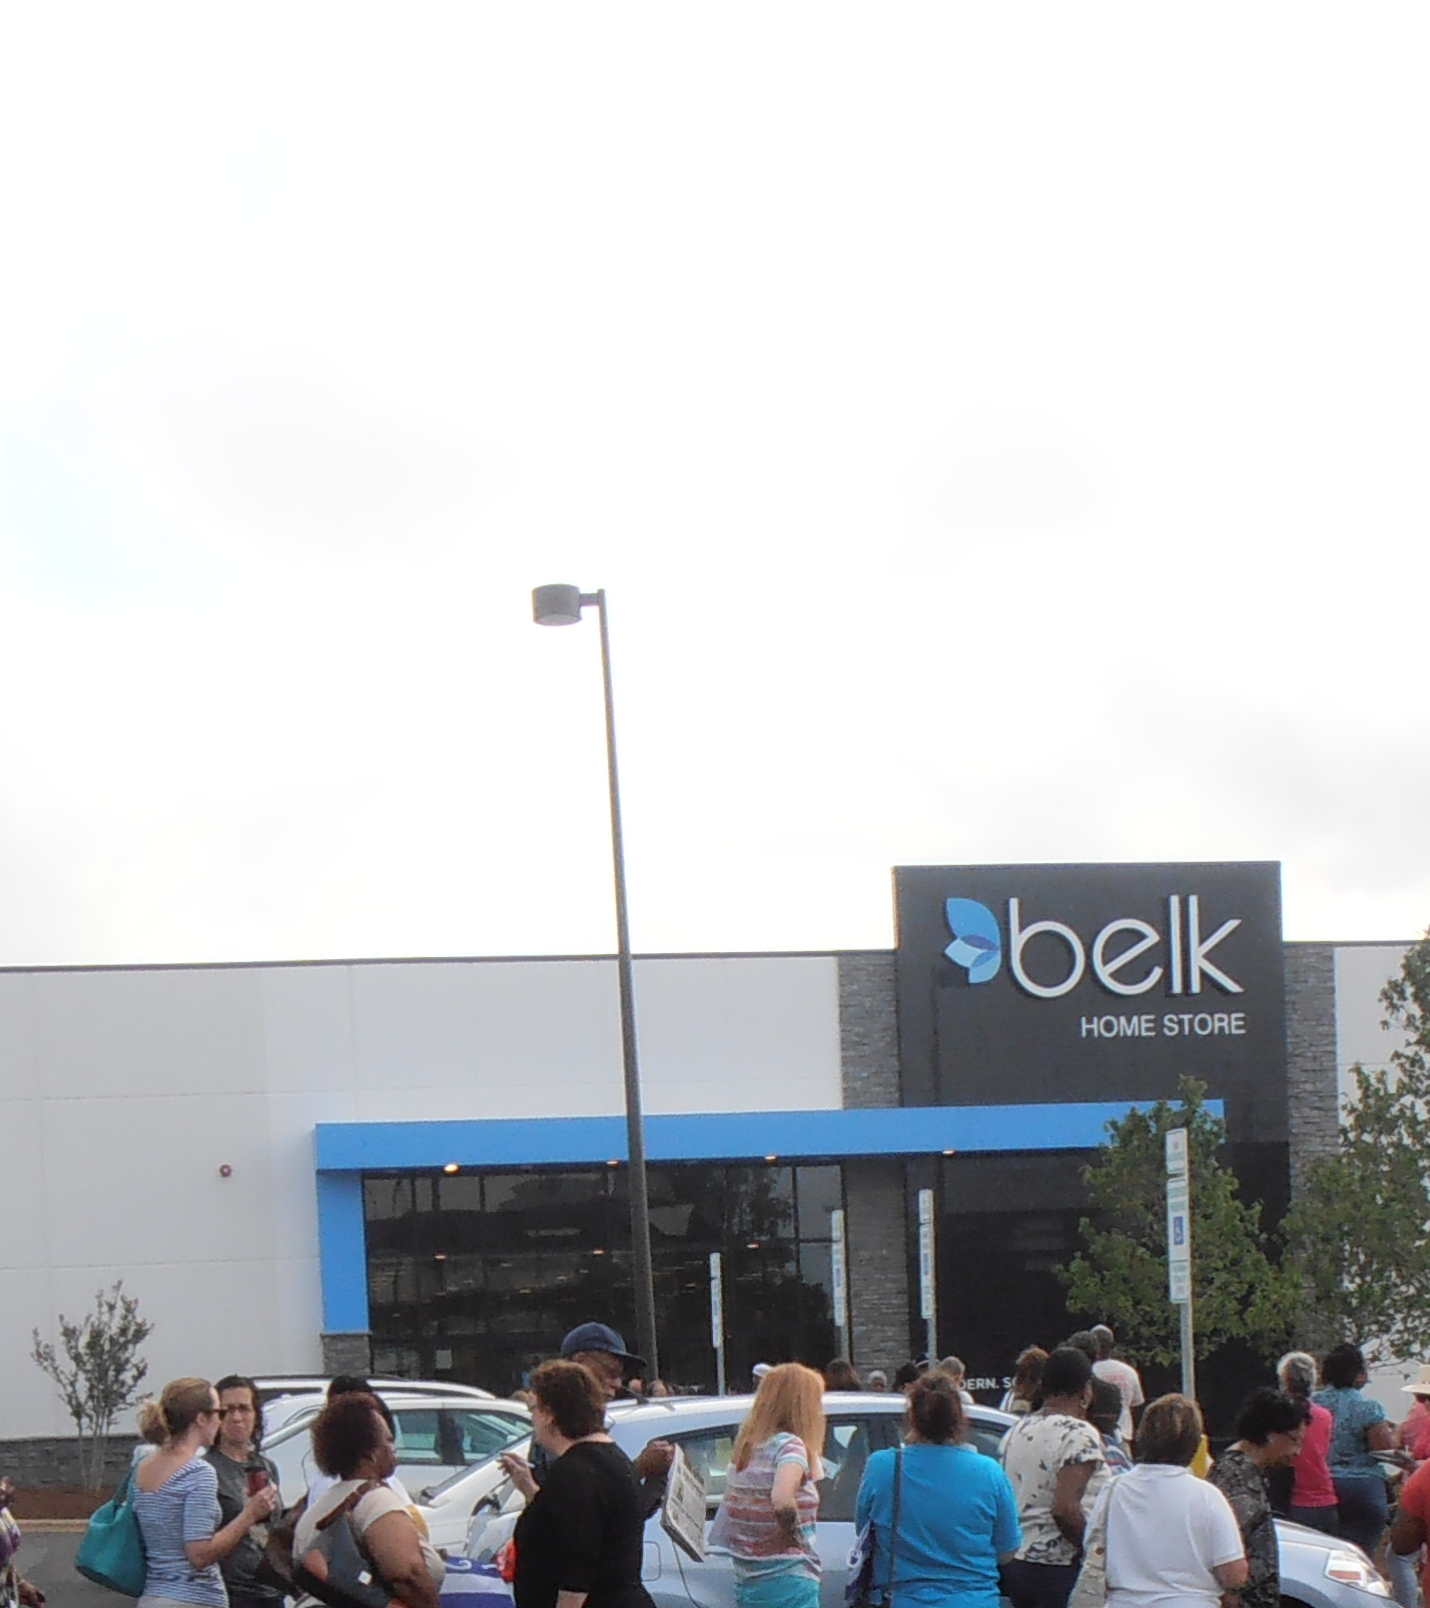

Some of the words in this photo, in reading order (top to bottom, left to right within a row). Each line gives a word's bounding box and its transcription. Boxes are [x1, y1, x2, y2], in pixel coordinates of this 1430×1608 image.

[1009, 894, 1245, 998] belk
[1081, 1015, 1156, 1038] HOME
[1163, 1012, 1247, 1036] STORE
[958, 1377, 1000, 1390] DERN.
